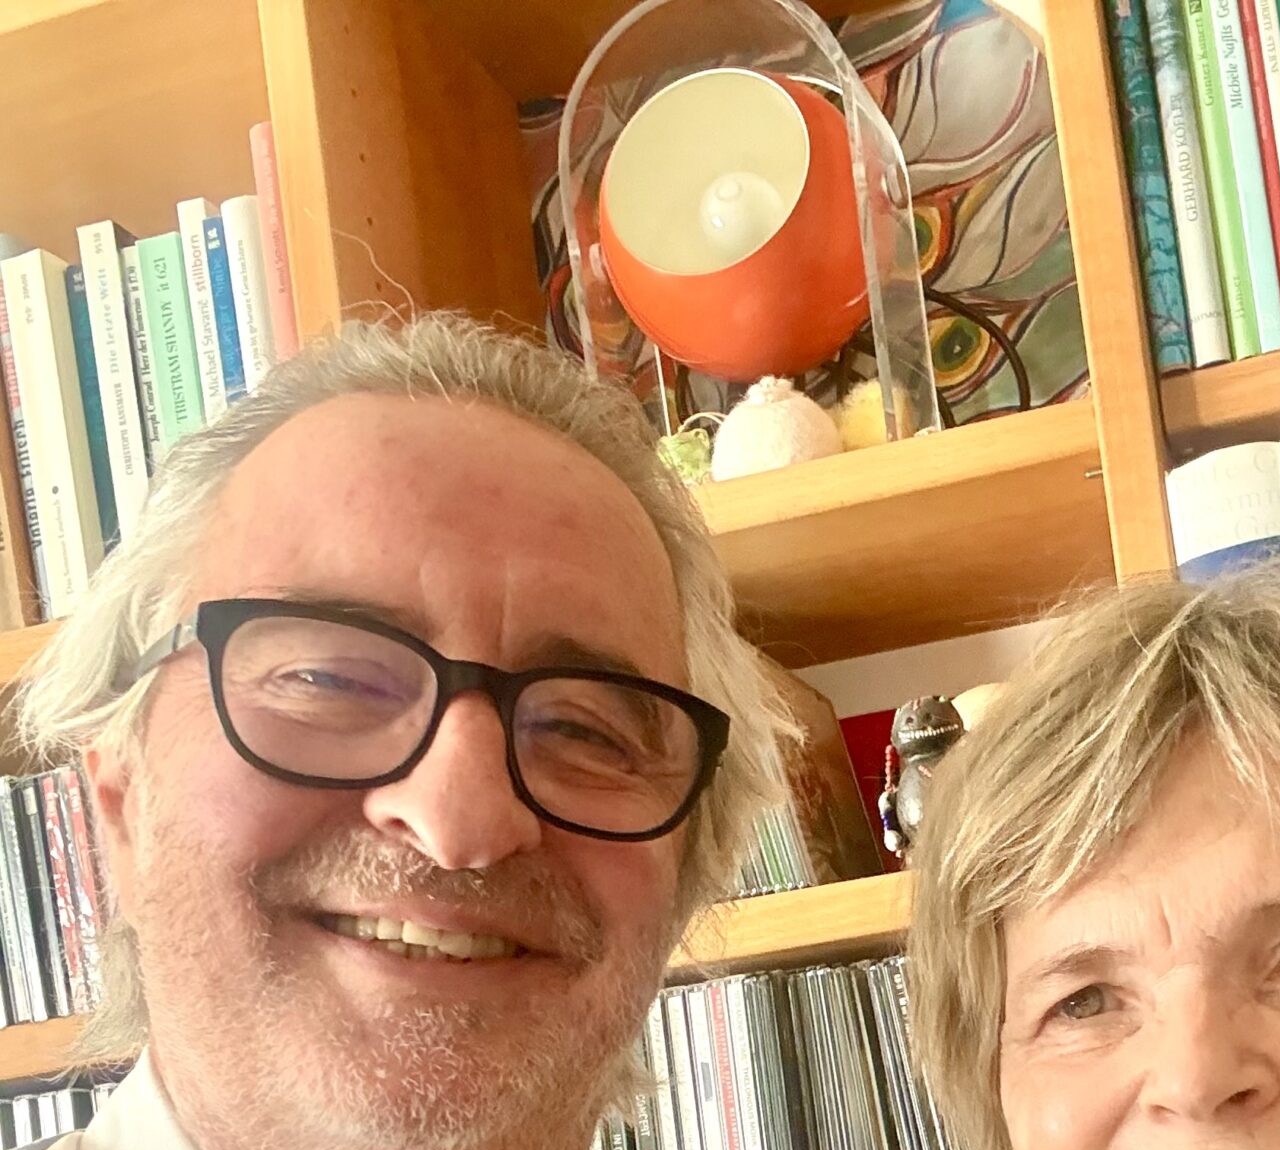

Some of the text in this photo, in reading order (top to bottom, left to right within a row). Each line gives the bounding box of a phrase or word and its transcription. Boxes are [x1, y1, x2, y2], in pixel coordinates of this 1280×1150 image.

[1177, 150, 1199, 221] GERHARD
[152, 255, 188, 423] TRISTRAM SHANDY 621
[187, 233, 220, 397] Michael stillborn
[612, 1133, 622, 1145] IN
